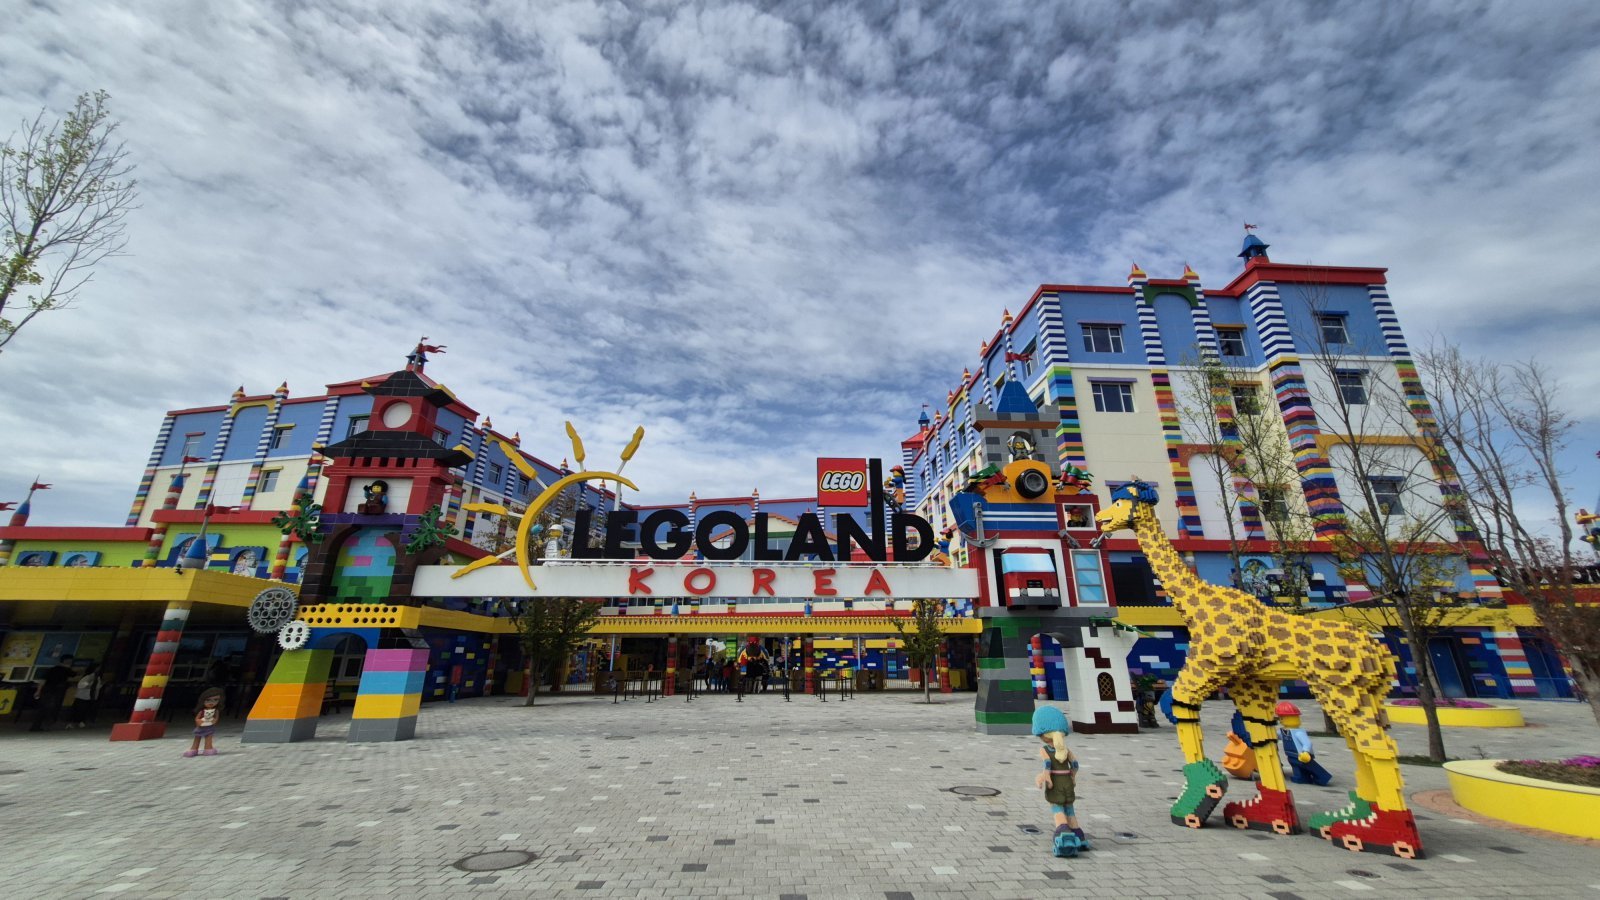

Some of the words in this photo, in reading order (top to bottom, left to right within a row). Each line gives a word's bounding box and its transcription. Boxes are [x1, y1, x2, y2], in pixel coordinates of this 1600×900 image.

[820, 471, 865, 491] LEGO
[571, 458, 935, 562] LEGOLAND
[628, 567, 892, 596] KOREA
